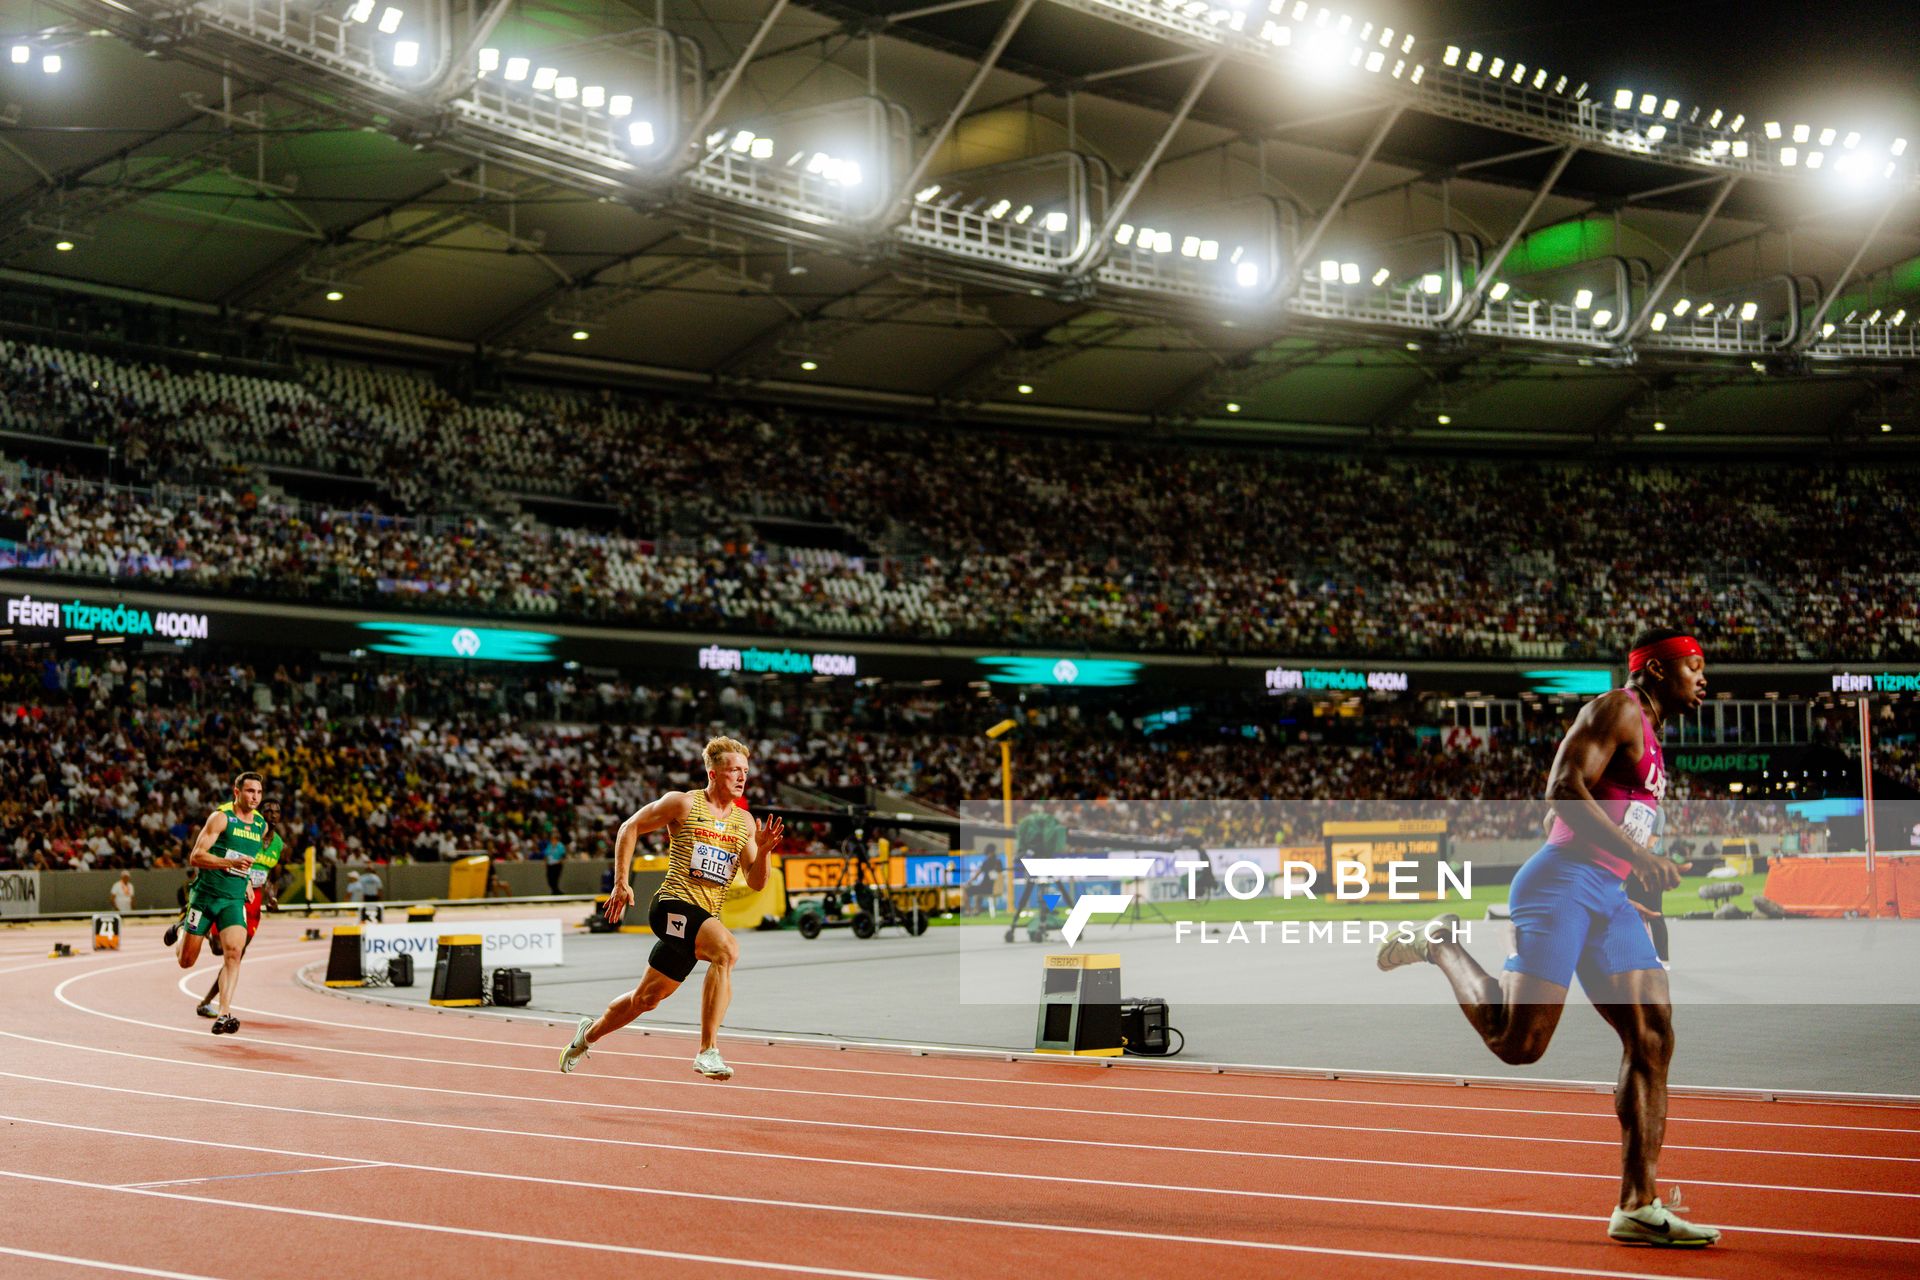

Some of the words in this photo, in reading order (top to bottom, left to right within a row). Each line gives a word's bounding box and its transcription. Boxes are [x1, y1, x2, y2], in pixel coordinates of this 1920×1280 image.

[8, 595, 59, 628] FÉRFI
[61, 600, 153, 634] TÍZPRÓBA
[155, 611, 208, 639] 400M
[1832, 672, 1873, 692] FÉRFI
[1675, 754, 1770, 771] BUDAPEST
[232, 827, 261, 842] AUSTRALIA
[694, 827, 739, 843] GERMANY
[708, 846, 736, 865] TDK
[701, 858, 726, 876] EITEL
[190, 911, 196, 922] 3
[99, 921, 115, 940] 4
[671, 920, 684, 932] 4
[485, 933, 554, 951] SPORT
[1050, 957, 1079, 967] SEIKO
